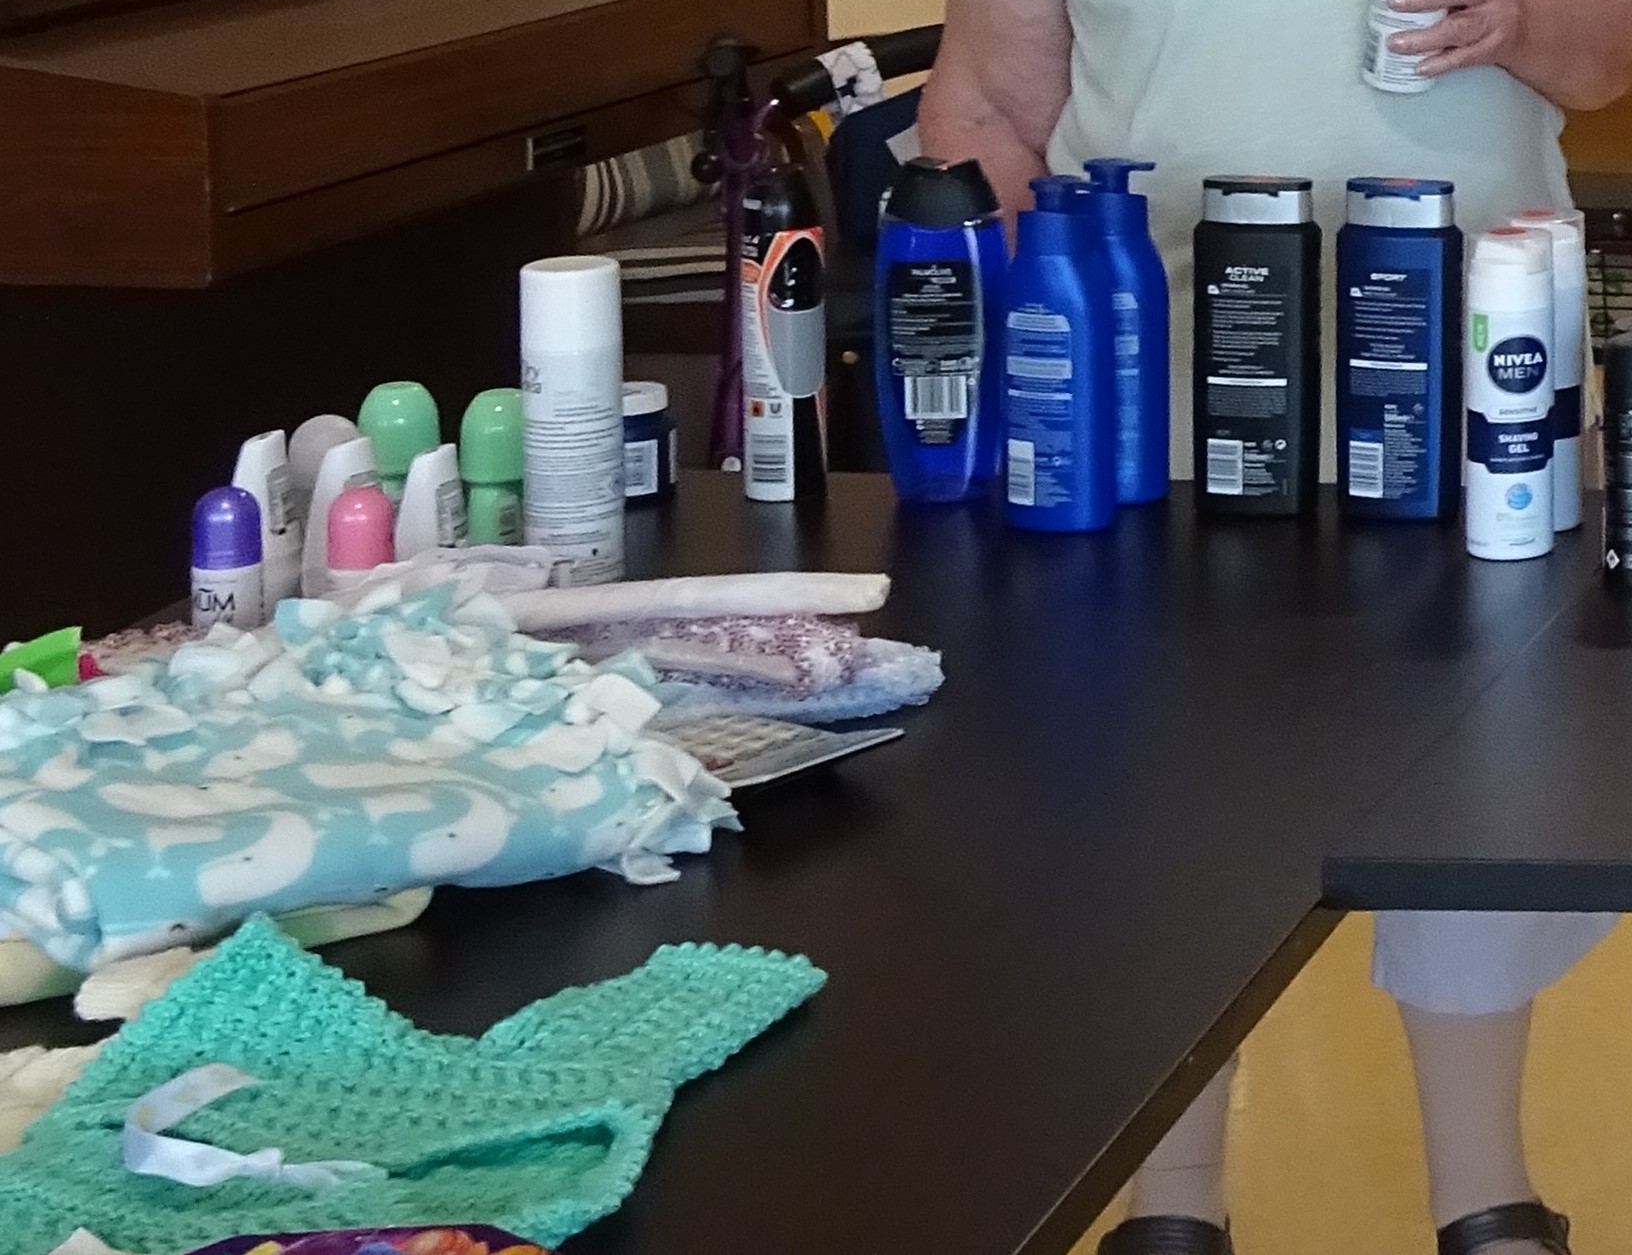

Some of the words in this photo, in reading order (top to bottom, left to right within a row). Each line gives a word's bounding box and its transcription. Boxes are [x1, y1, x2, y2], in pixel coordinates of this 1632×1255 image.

[1224, 266, 1270, 276] ACTIVE
[1493, 352, 1544, 368] NIVEA
[1498, 367, 1540, 380] MEN
[1508, 443, 1530, 454] GEL
